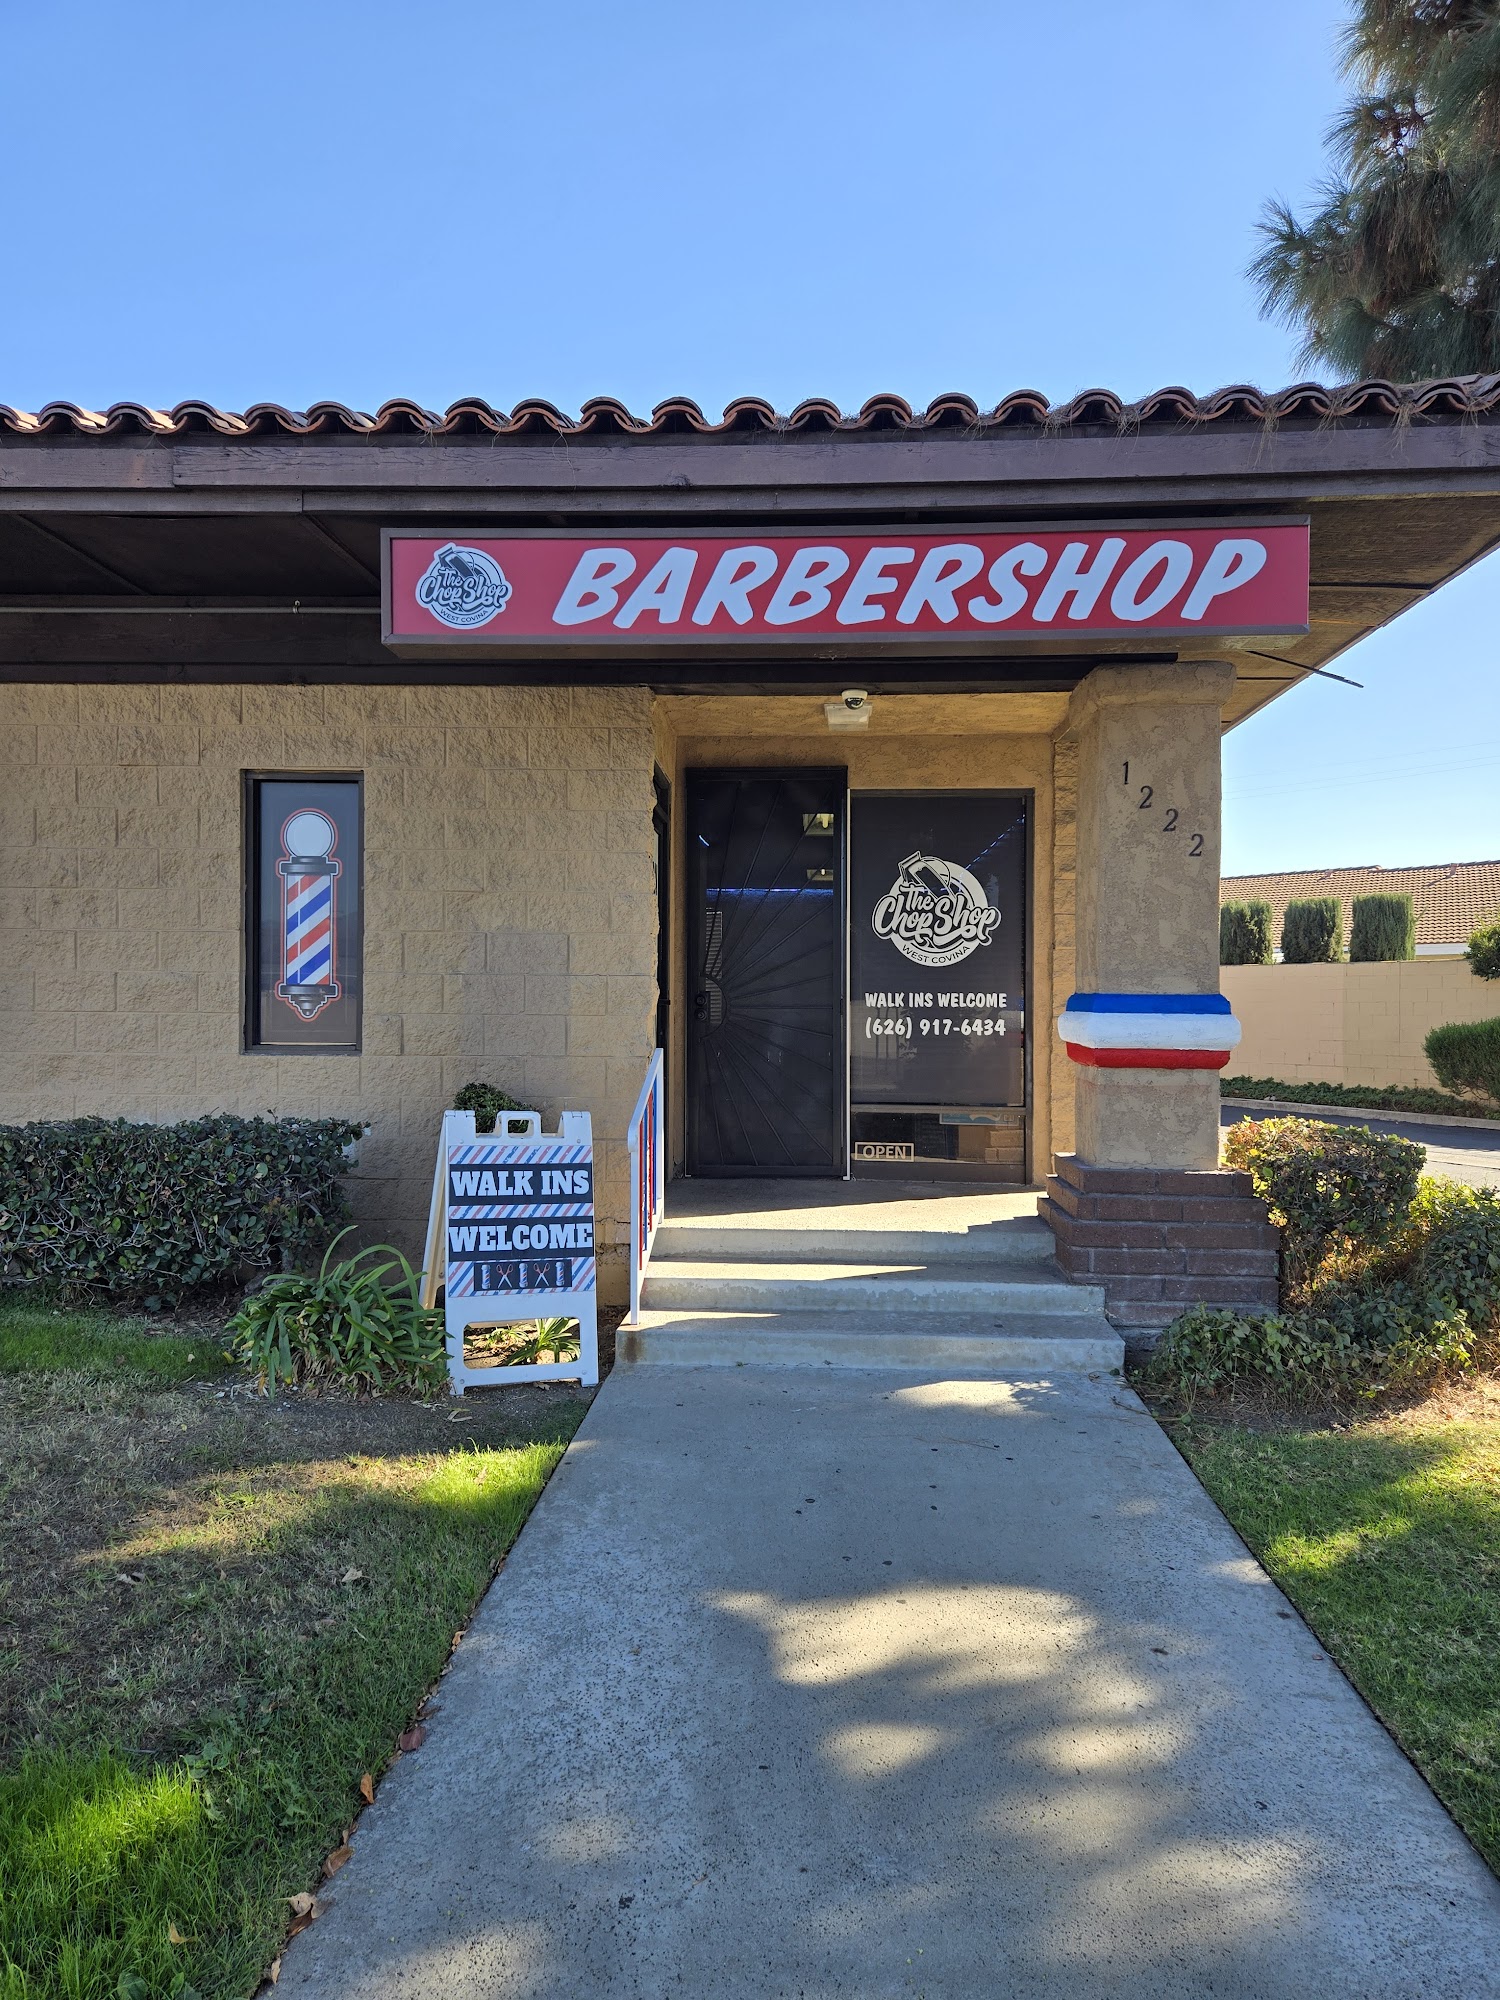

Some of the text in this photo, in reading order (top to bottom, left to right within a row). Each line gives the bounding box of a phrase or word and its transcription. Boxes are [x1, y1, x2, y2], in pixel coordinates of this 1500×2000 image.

[439, 567, 463, 587] The
[552, 537, 1268, 629] BARBERSHOP
[420, 575, 508, 612] Chop Shop
[440, 609, 488, 623] WEST COVINA
[900, 884, 934, 911] The
[873, 893, 998, 947] Chop Shop
[902, 944, 971, 964] WEST COVINA
[864, 992, 1008, 1008] WALK INS WELCOME
[865, 1016, 1006, 1039] (626) 917-6434
[862, 1145, 907, 1160] OPEN
[450, 1169, 590, 1197] WALK INS
[448, 1222, 593, 1253] WELCOME
